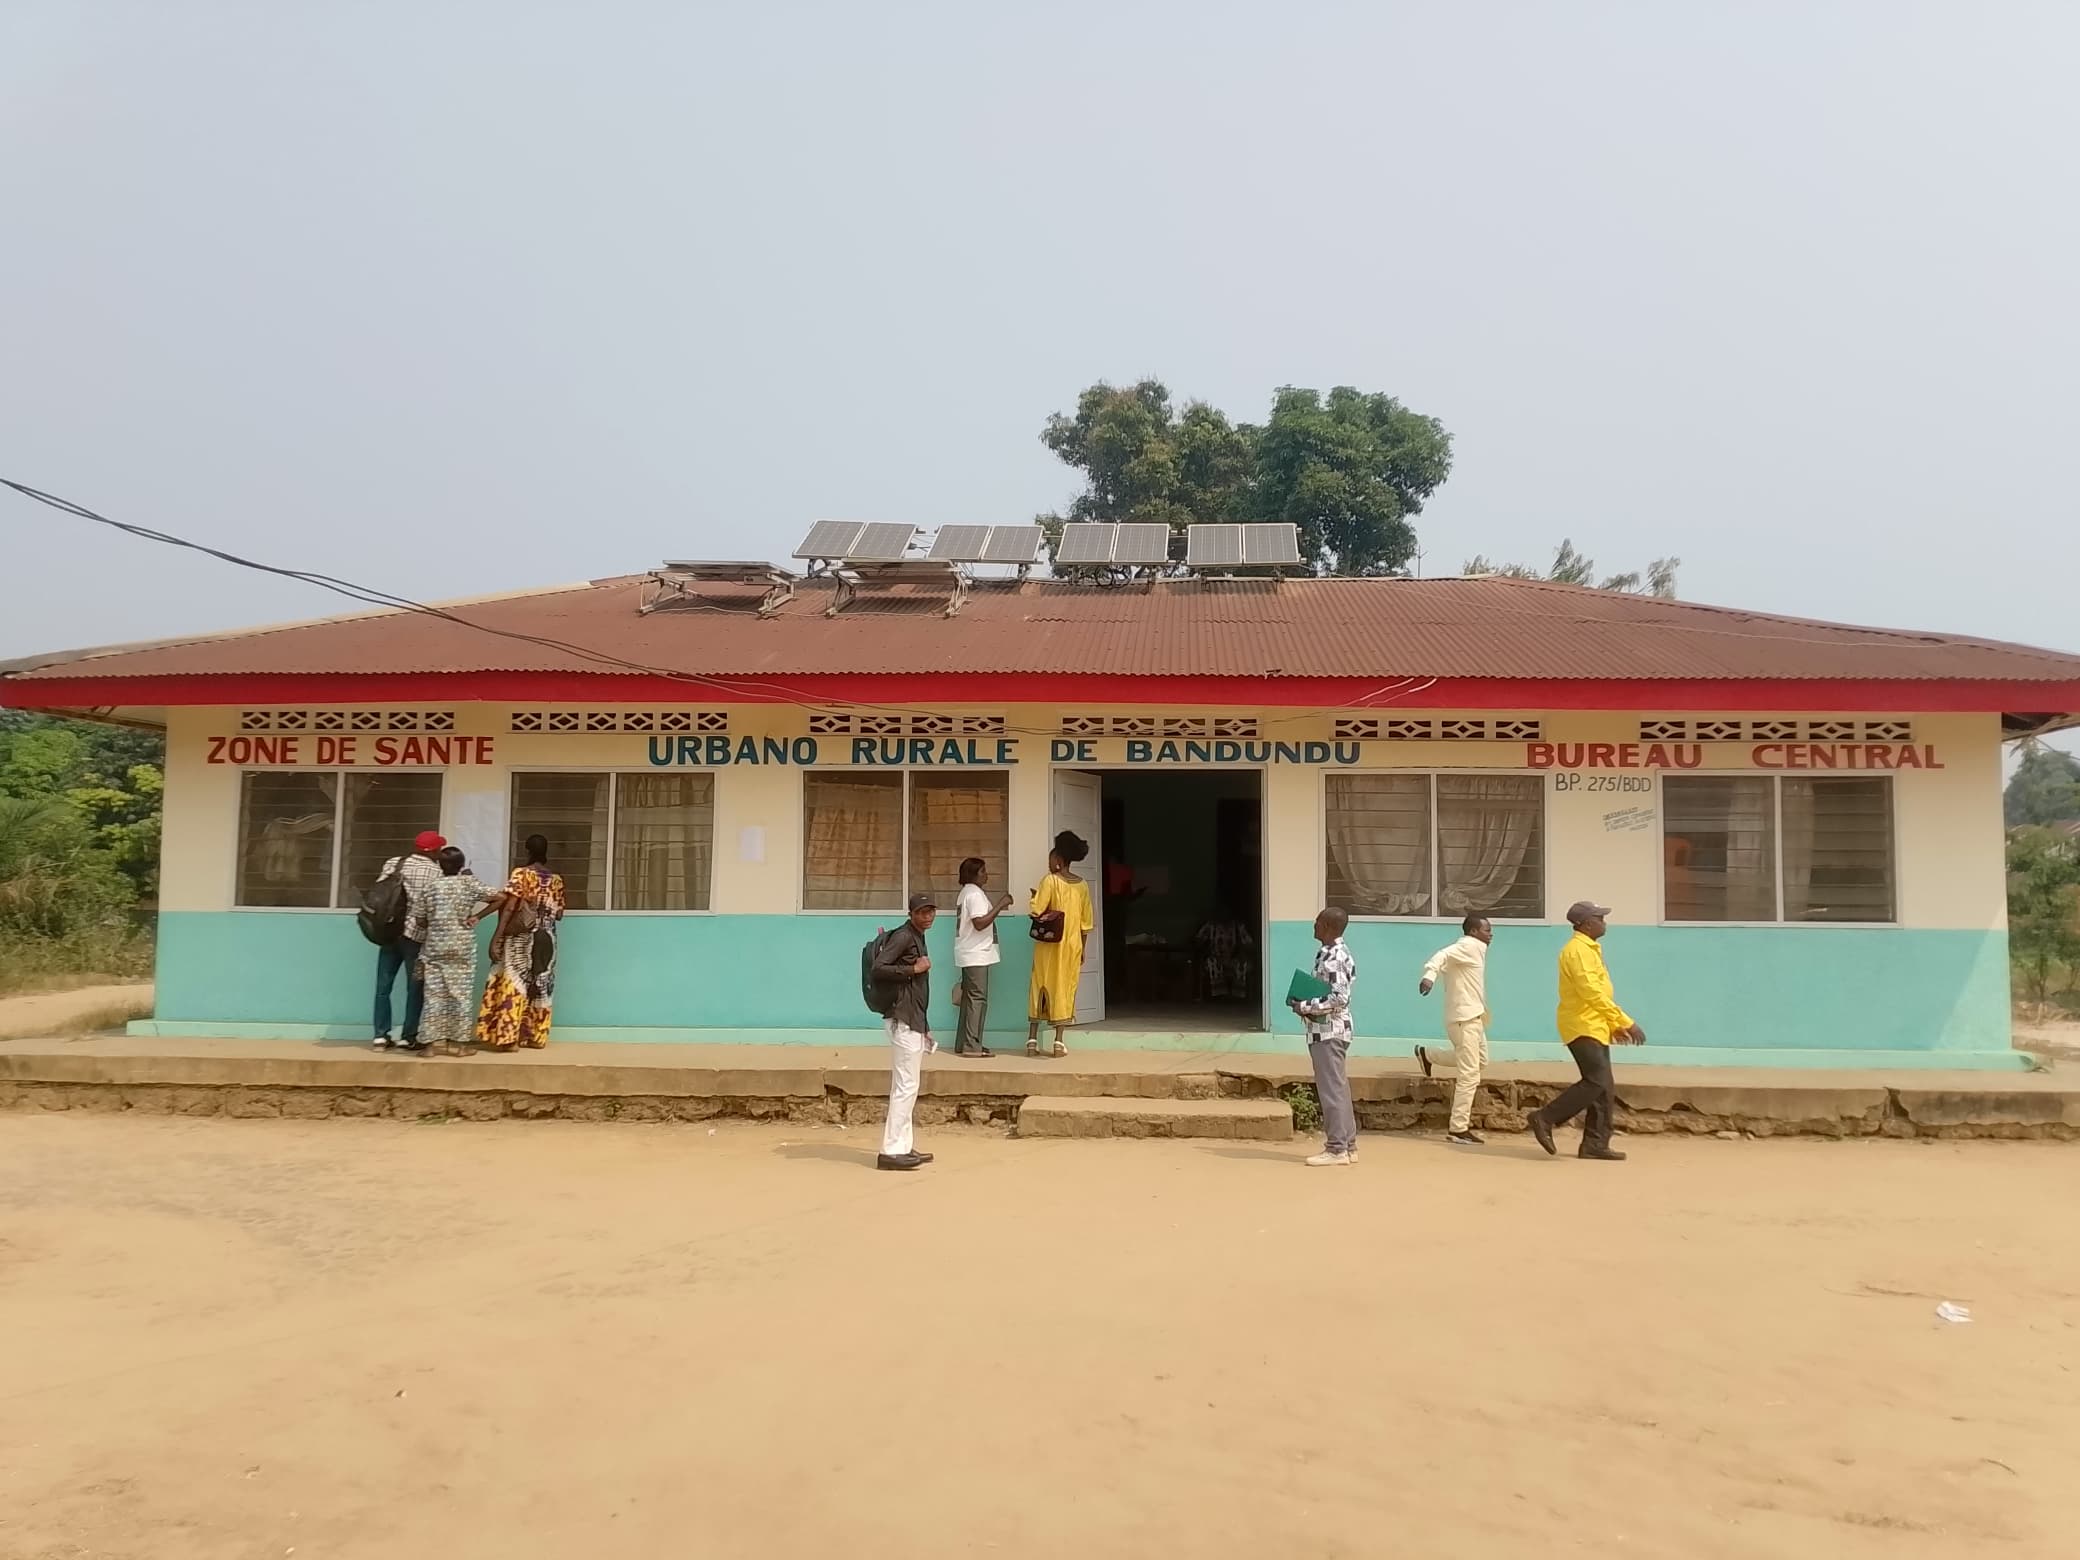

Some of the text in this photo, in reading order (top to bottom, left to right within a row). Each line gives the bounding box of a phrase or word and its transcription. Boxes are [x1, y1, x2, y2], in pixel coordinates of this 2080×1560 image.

[207, 736, 494, 765] ZONE DE SANTE
[648, 736, 1361, 766] URBANO RURALE DE BANDUNDU
[1526, 743, 1945, 770] BUREAU CENTRAL
[1555, 772, 1652, 793] BP. 275/BDD
